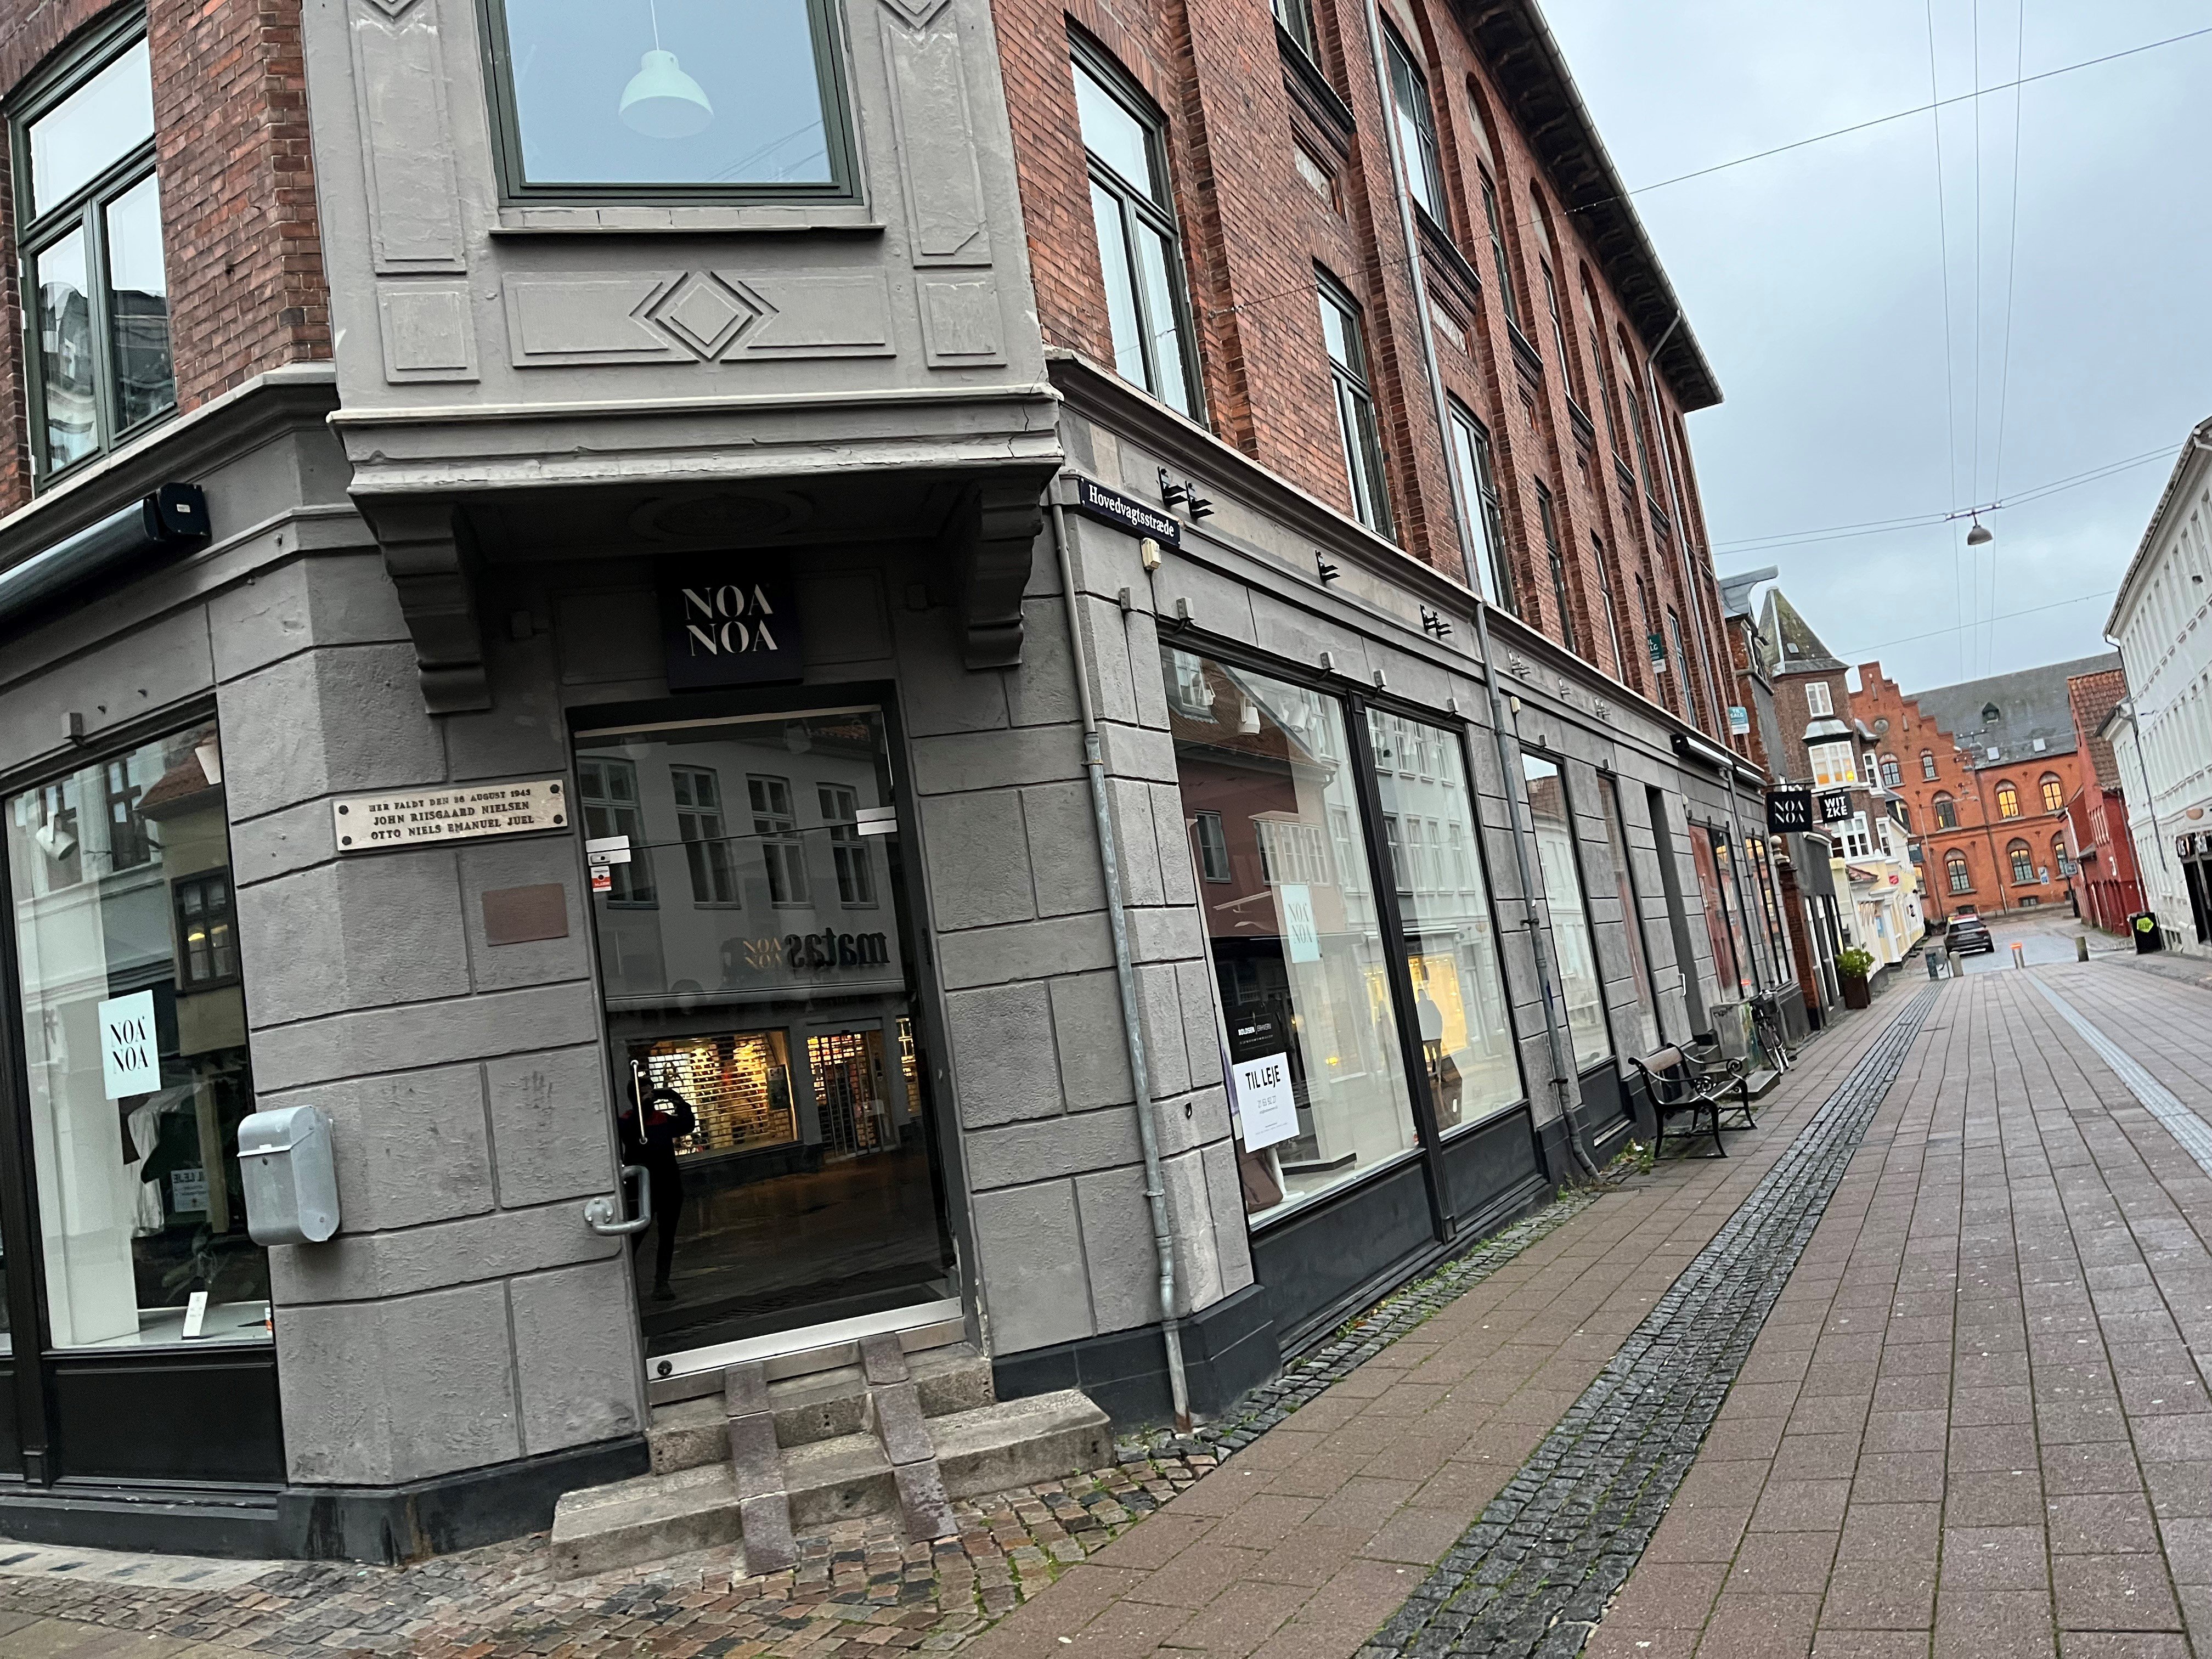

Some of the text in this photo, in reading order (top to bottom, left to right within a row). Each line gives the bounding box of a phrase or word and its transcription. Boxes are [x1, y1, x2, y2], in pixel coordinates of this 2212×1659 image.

[1088, 484, 1174, 537] Hovedvagtsstræde
[682, 584, 773, 619] NOA
[686, 619, 778, 656] NOA
[394, 800, 424, 810] FALDT
[430, 797, 449, 806] DEN
[471, 791, 505, 802] AUGUST
[1775, 800, 1804, 812] NOA
[1824, 796, 1845, 808] WIT
[1826, 805, 1848, 818] ZKE
[374, 802, 530, 826] JOHN RIISGAARD NIELSEN
[1775, 812, 1804, 824] NOA
[371, 816, 534, 839] OTTO NIELS EMANUEL JUEL
[112, 1044, 149, 1074] NOA
[1245, 1065, 1280, 1090] TIL LEJE
